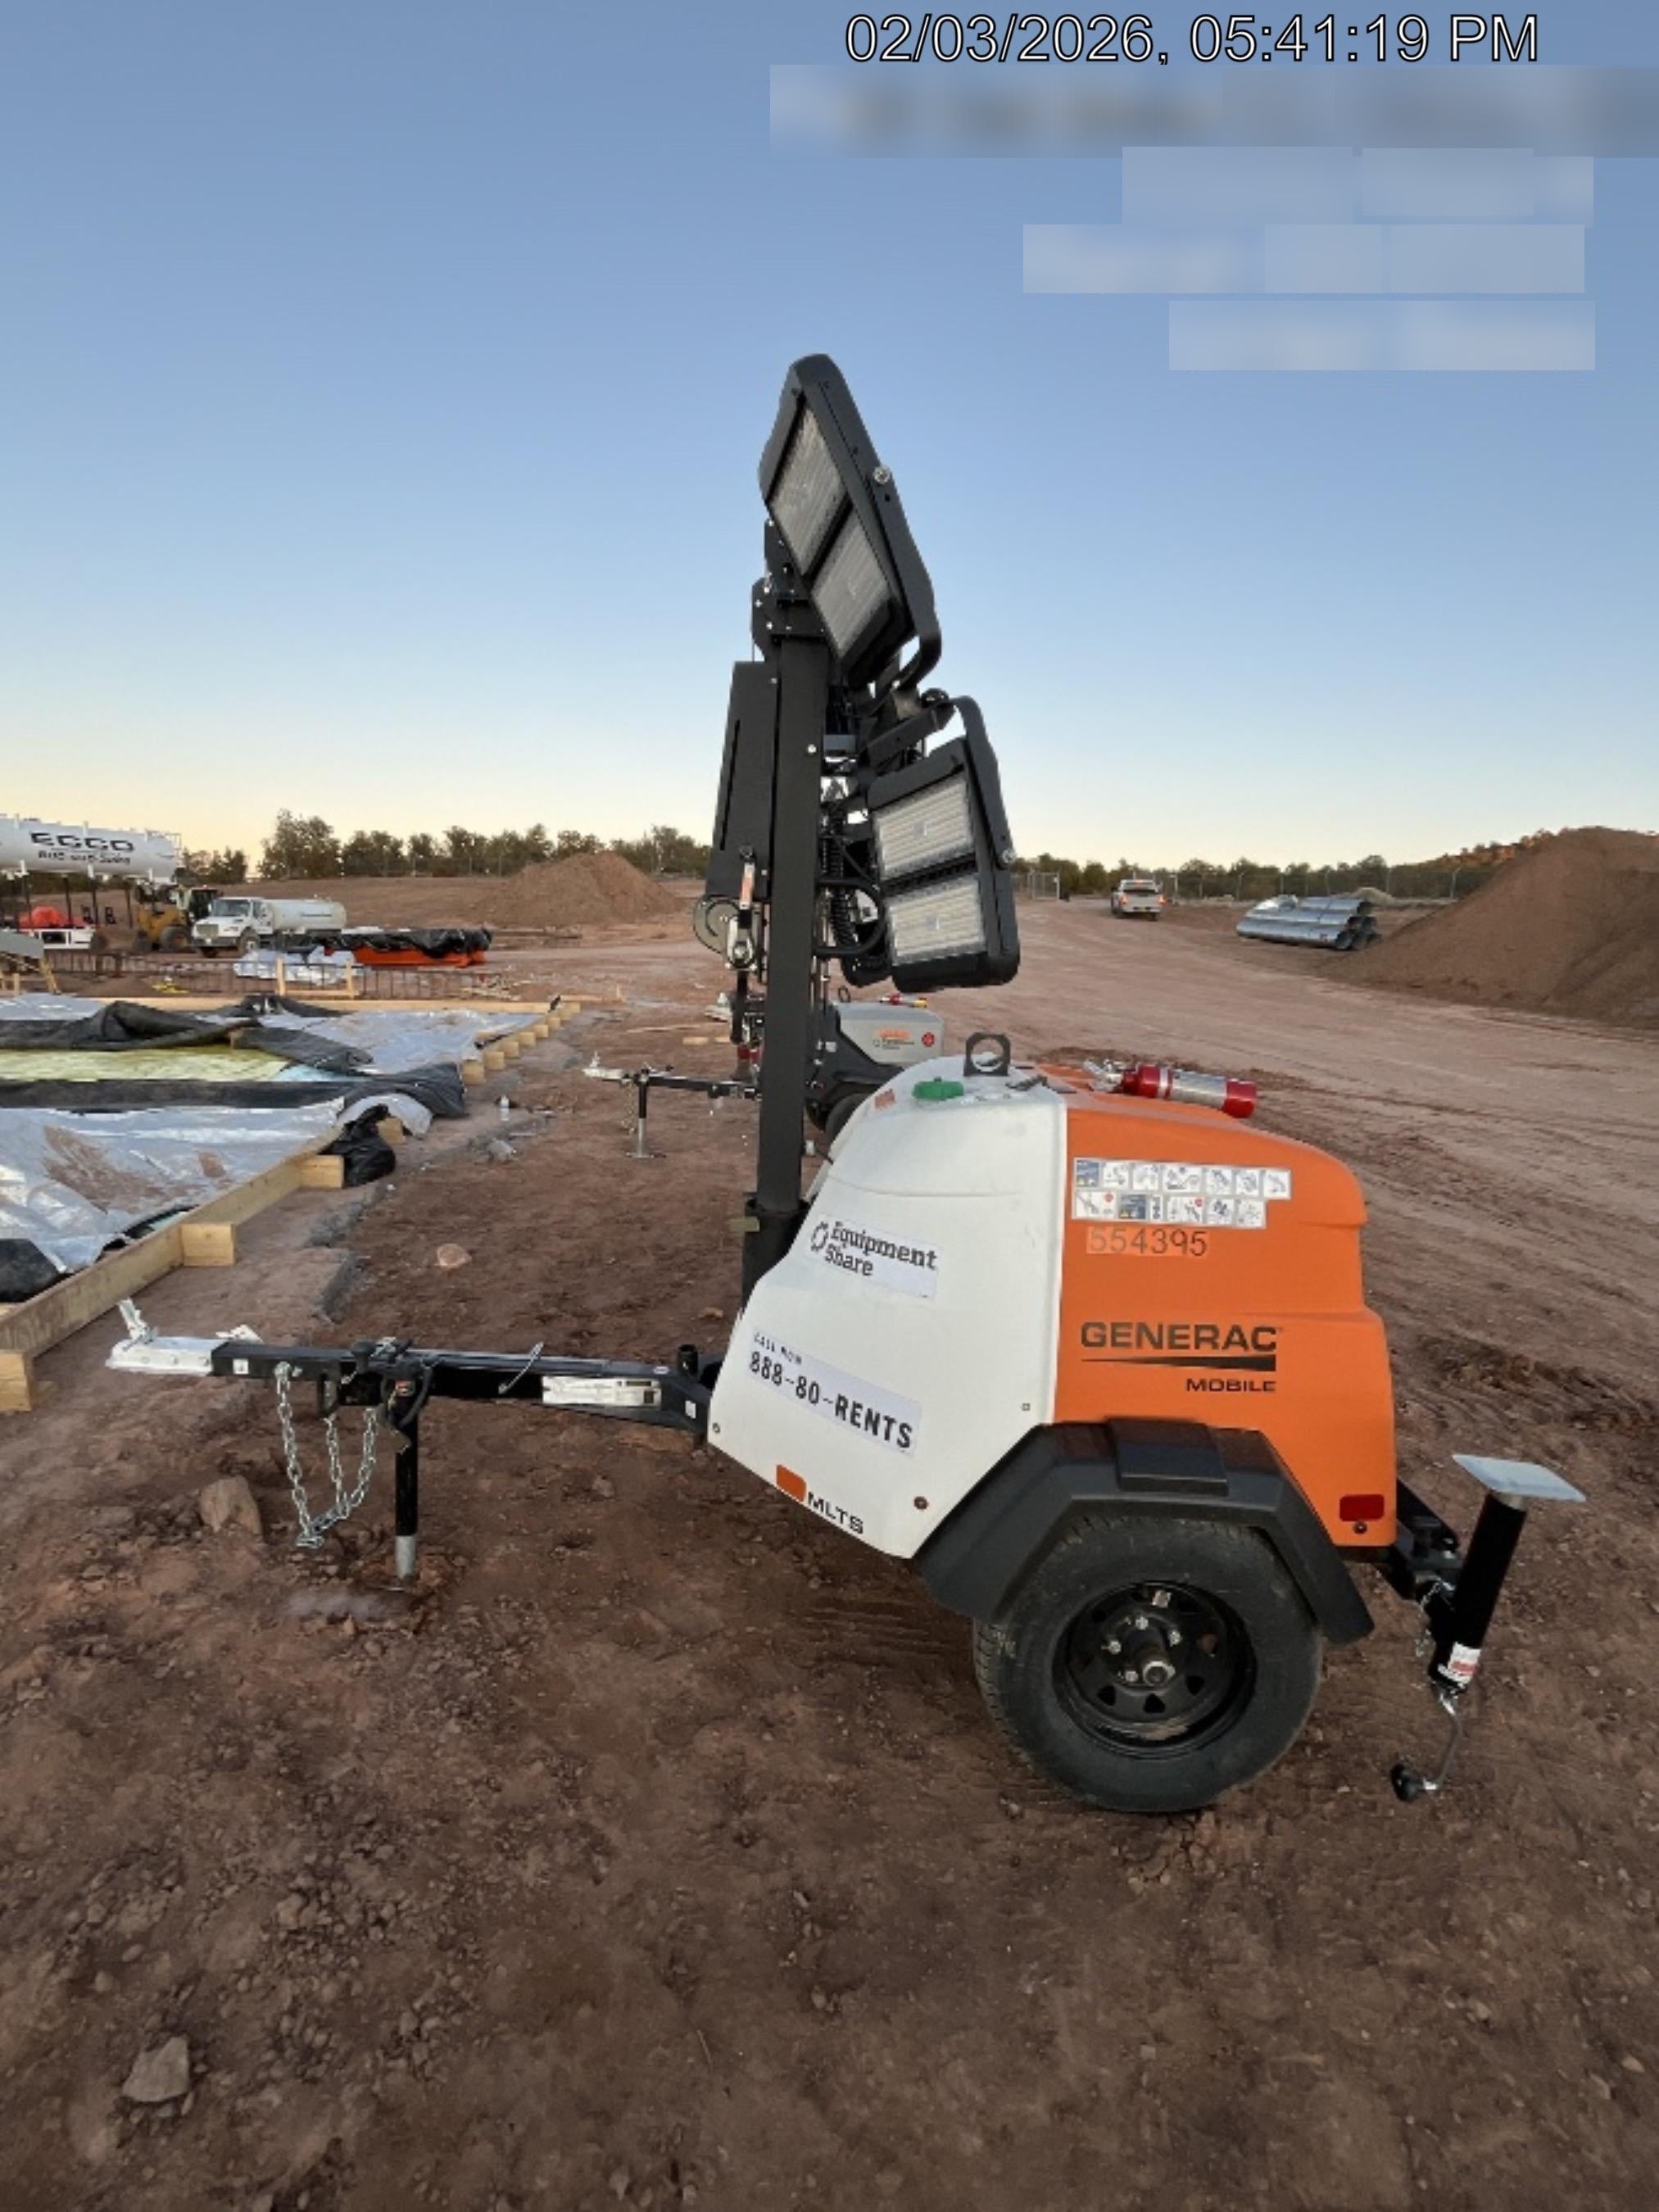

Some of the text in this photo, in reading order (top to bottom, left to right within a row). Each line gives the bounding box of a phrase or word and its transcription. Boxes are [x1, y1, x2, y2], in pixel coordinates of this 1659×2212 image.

[831, 1221, 938, 1271] Equipment
[1090, 1227, 1208, 1258] 554395
[824, 1243, 874, 1276] Share
[1081, 1321, 1277, 1353] GENERAC
[749, 1350, 913, 1449] 888-80-RENTS
[1185, 1377, 1277, 1393] MOBILE
[807, 1490, 863, 1535] MLTS
